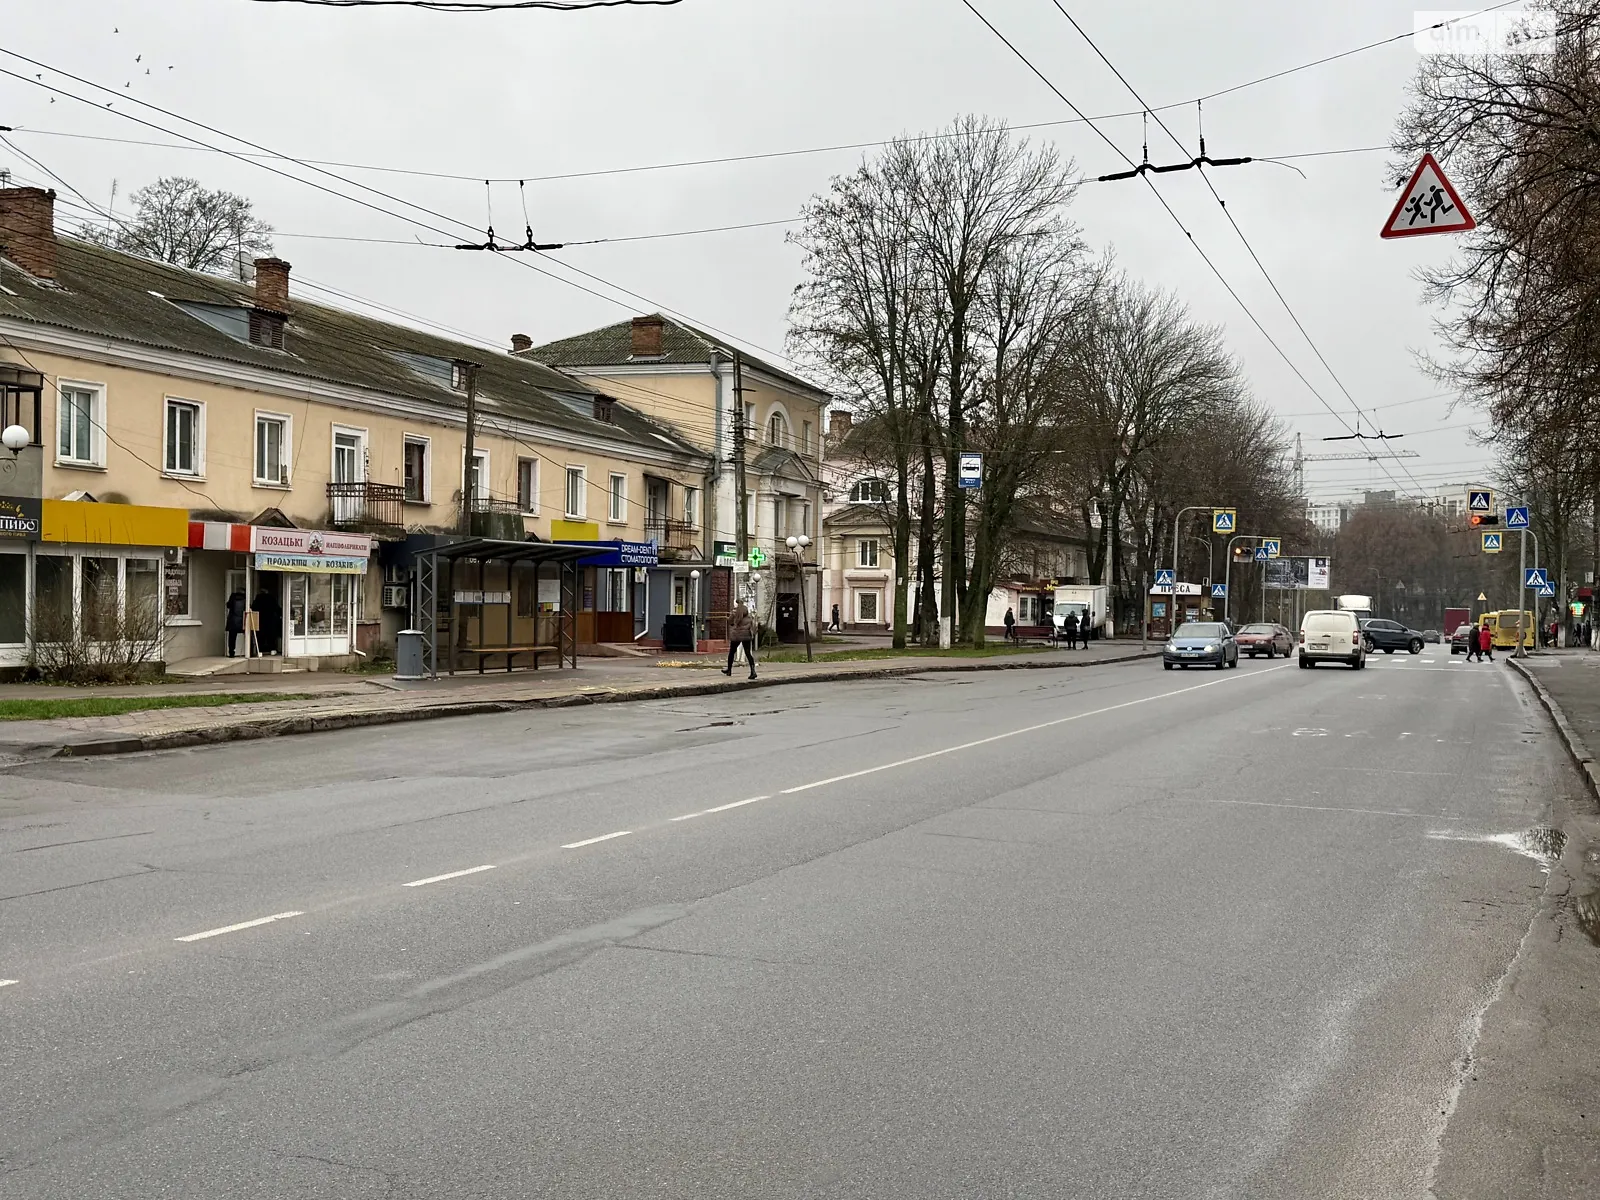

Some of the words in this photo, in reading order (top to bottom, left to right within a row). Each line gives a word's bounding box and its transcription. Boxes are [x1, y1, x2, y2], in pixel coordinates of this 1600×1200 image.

[261, 535, 303, 548] КОЗАЦЬКІ
[621, 544, 652, 555] DREAM-DENT
[621, 554, 658, 565] СТОМАТОЛОГІЯ
